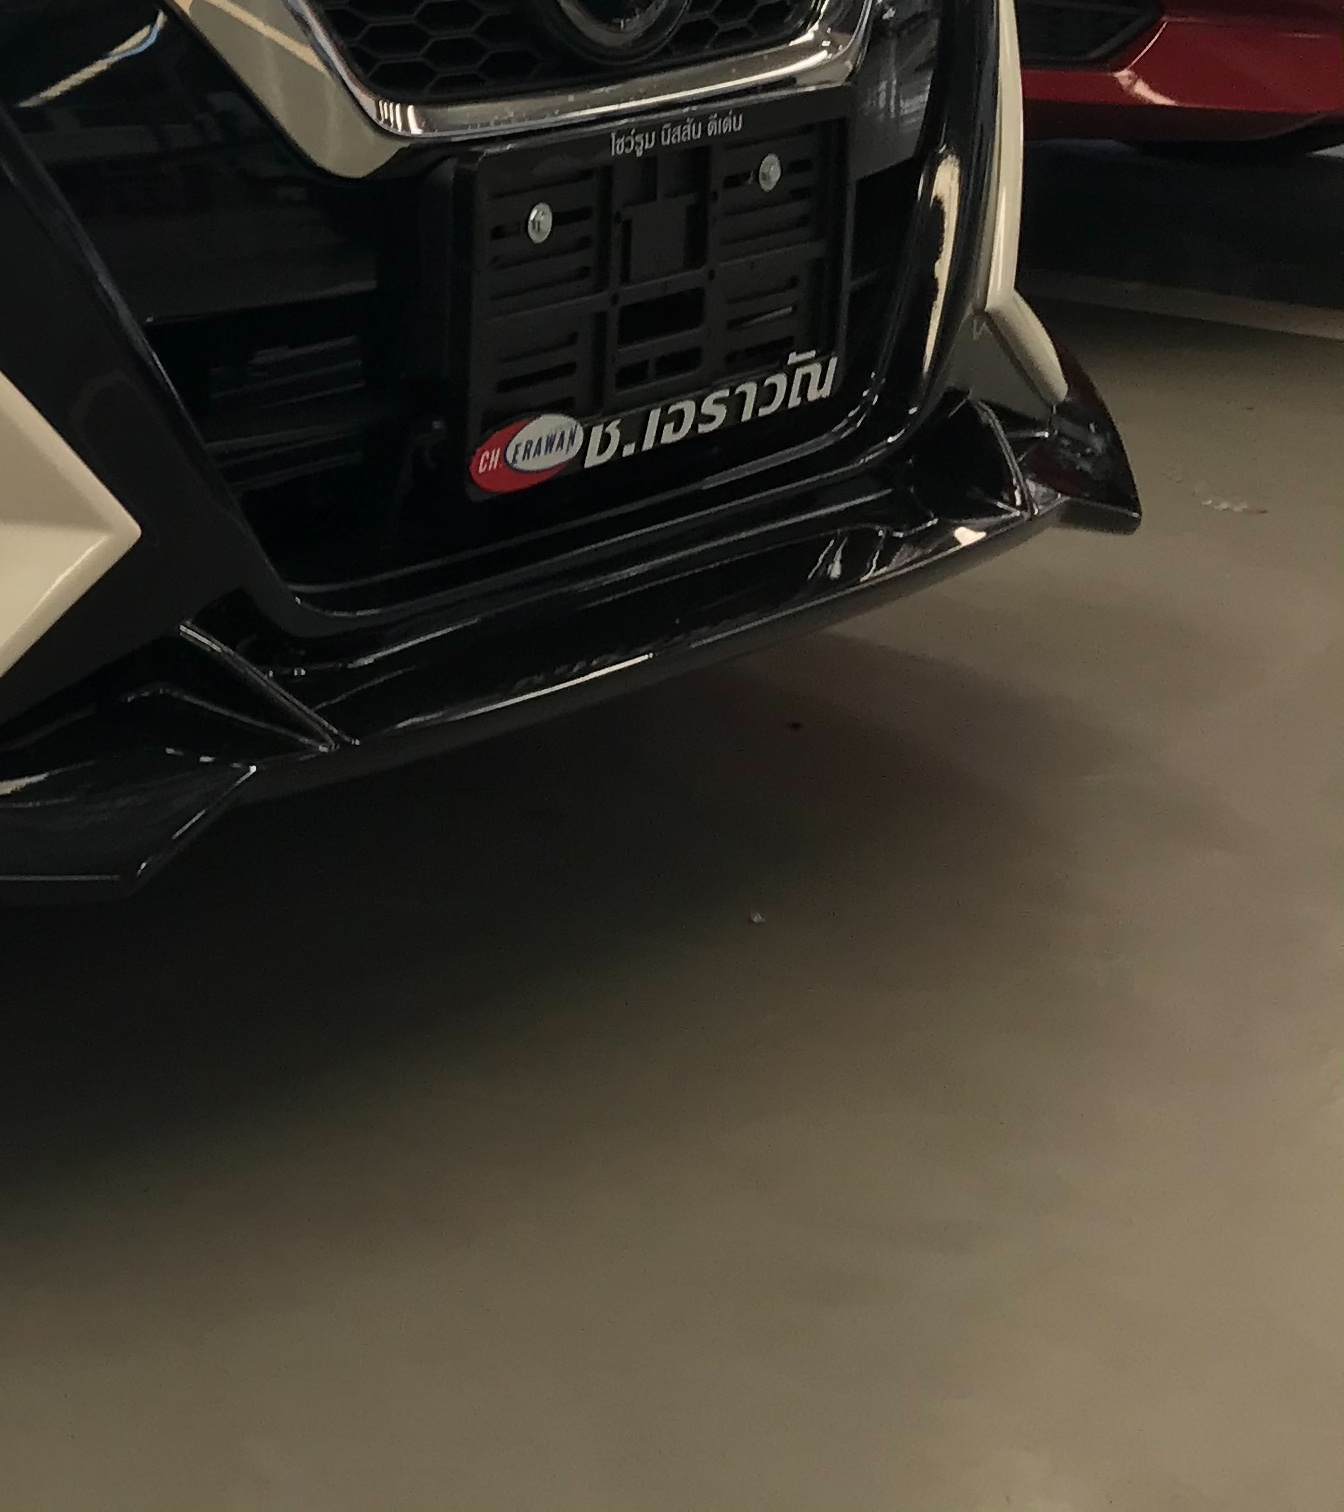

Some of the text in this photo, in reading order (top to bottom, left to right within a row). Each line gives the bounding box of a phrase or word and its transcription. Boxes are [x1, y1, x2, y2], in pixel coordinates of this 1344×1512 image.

[661, 117, 702, 147] นิสสัน
[511, 422, 579, 464] ERAWAN
